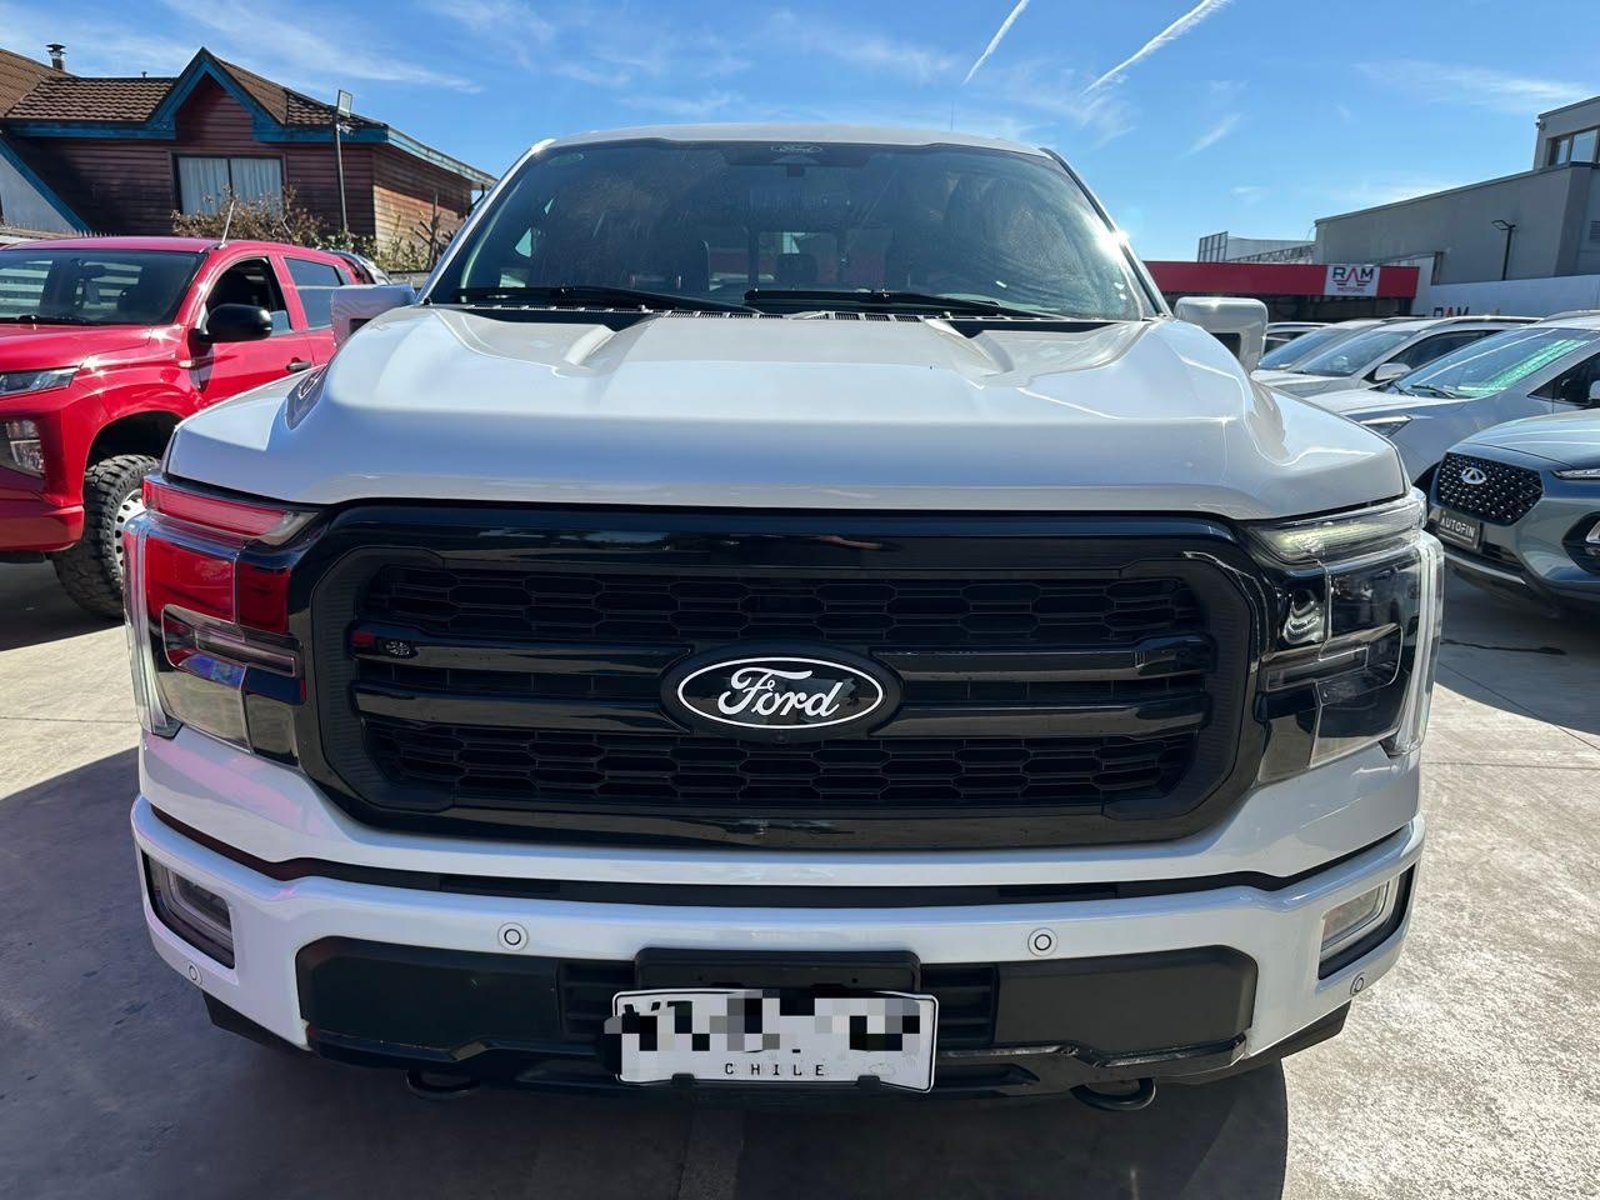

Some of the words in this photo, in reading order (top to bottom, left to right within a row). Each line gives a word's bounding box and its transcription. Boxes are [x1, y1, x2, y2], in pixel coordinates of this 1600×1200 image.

[1332, 266, 1374, 282] RAM
[1440, 517, 1476, 538] AUTOFIN
[717, 667, 844, 717] Ford
[724, 1062, 825, 1076] CHILE
